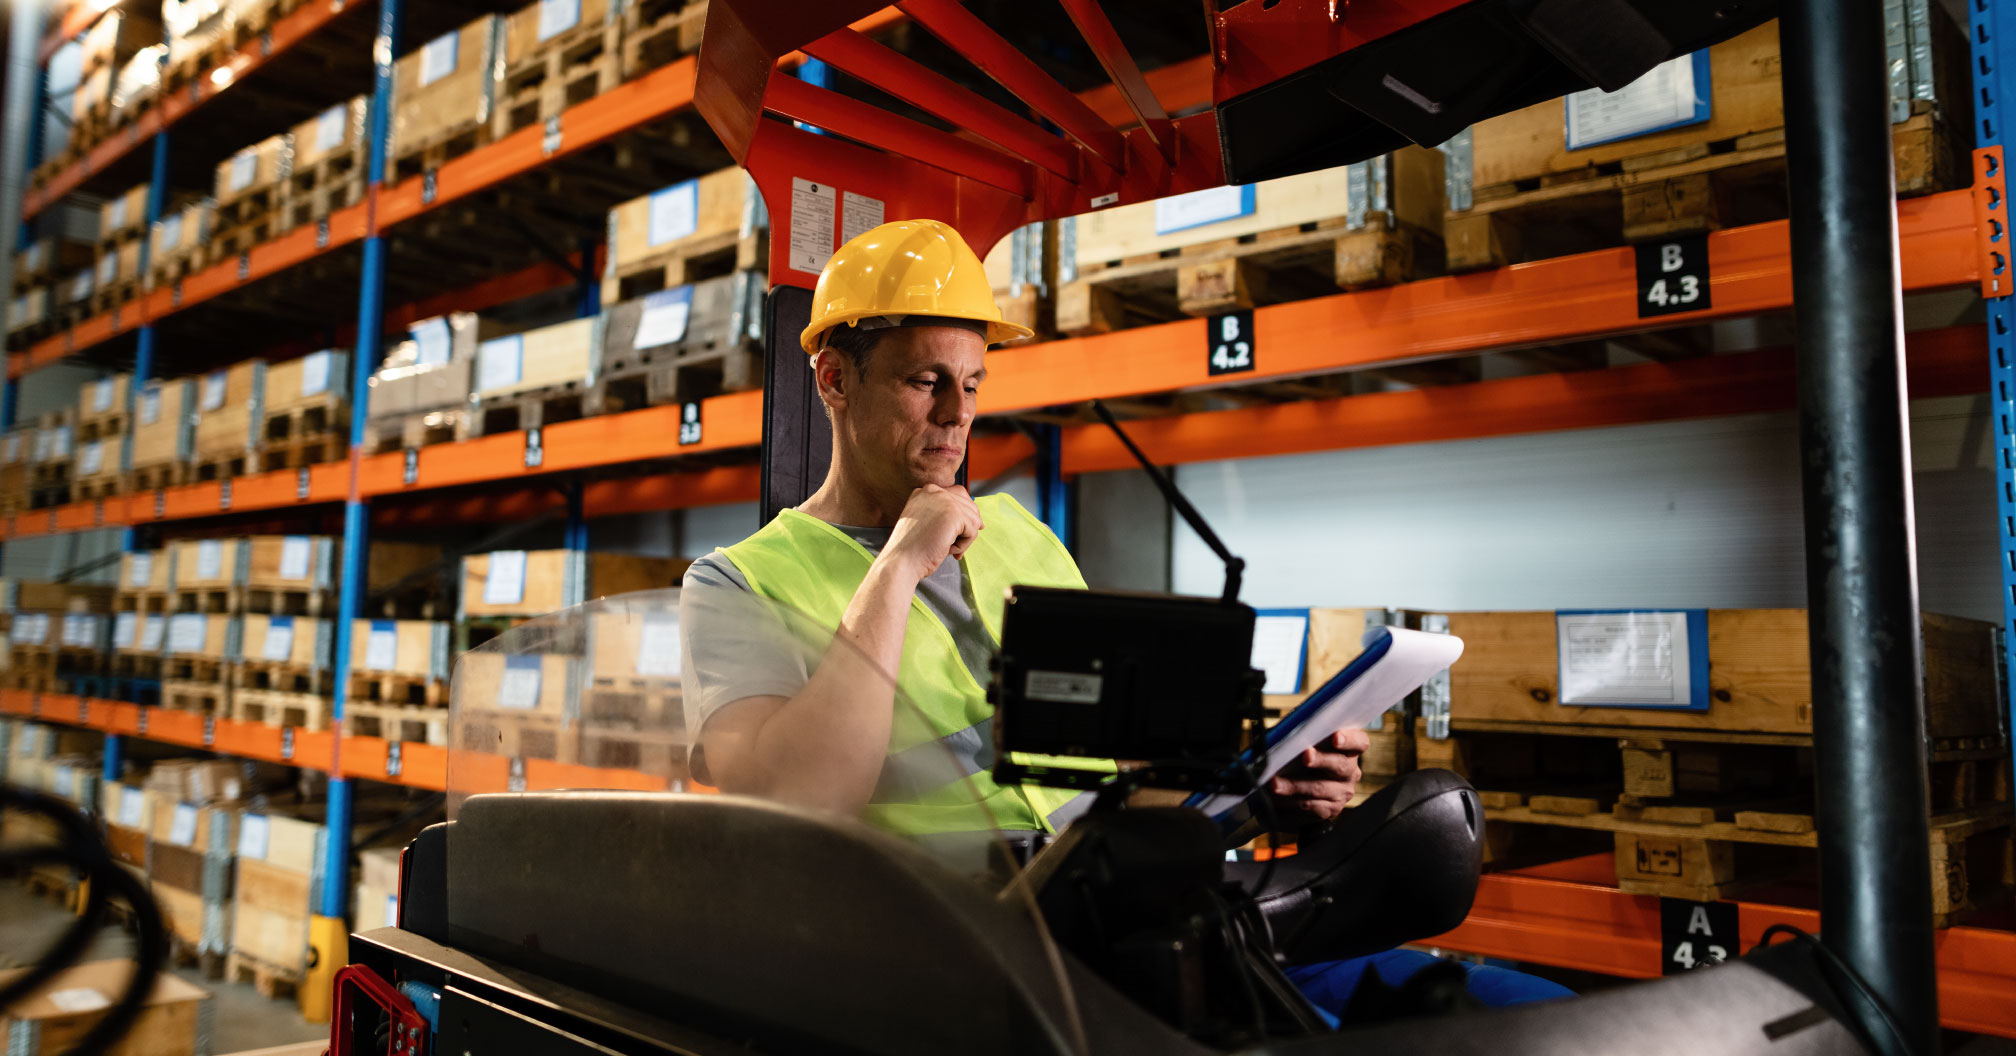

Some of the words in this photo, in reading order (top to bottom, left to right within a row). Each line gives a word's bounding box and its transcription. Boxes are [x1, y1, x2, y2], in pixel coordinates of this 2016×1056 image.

[1661, 243, 1683, 272] B
[1647, 274, 1700, 307] 4.3
[1222, 315, 1239, 341] B
[1212, 342, 1250, 369] 4.2
[1687, 905, 1713, 937] A
